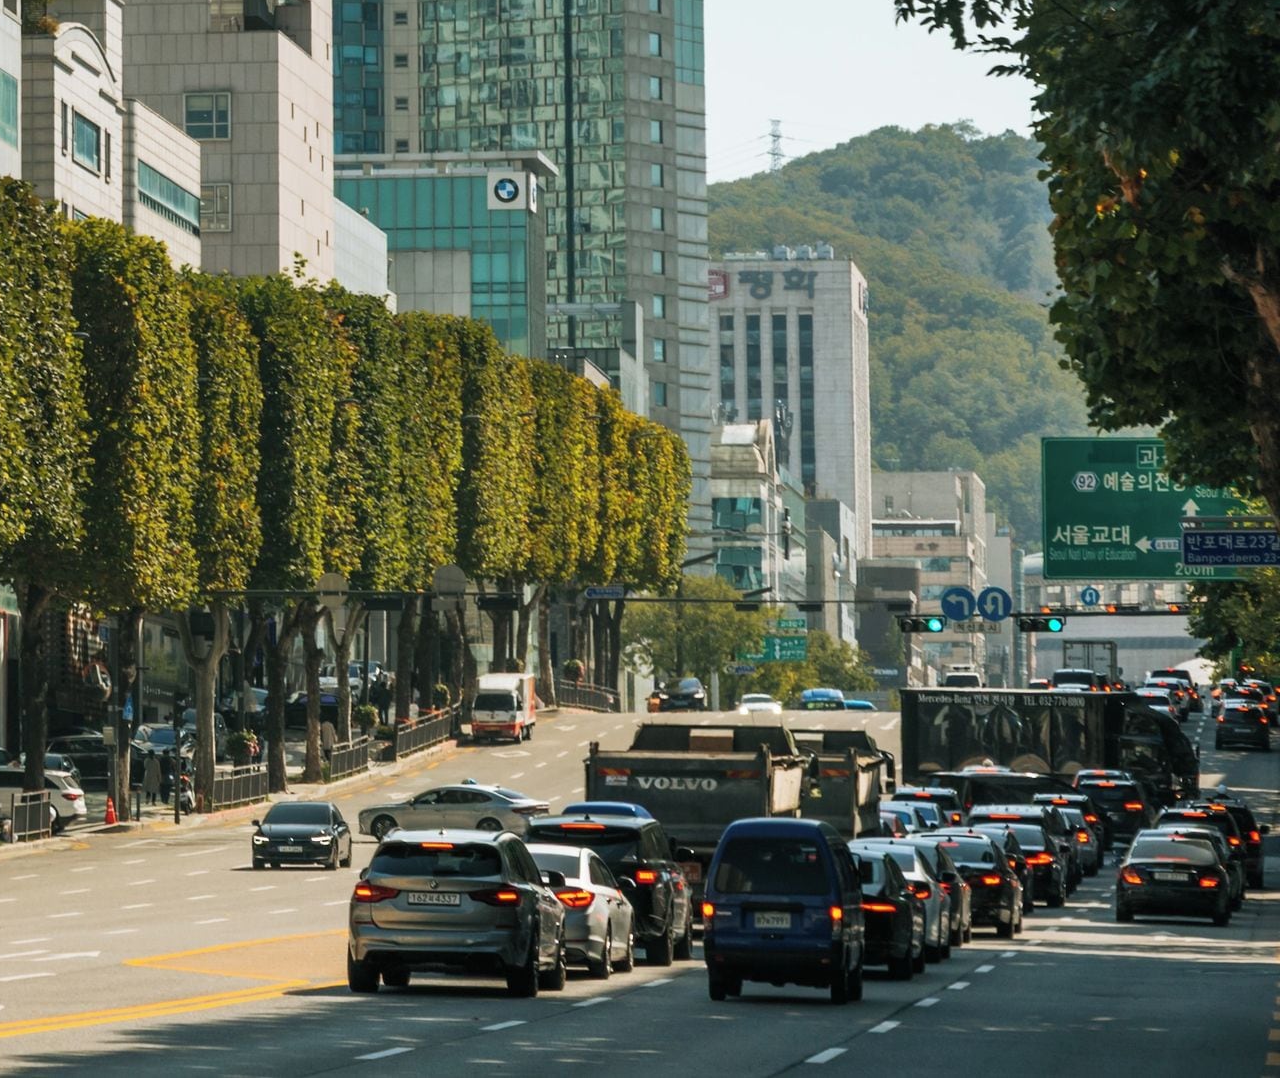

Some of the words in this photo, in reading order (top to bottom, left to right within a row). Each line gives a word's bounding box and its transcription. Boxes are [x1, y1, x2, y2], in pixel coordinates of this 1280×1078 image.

[1078, 474, 1094, 490] 92
[1195, 485, 1219, 499] Seoul
[1052, 524, 1131, 546] 서울교대
[1106, 547, 1137, 561] Education
[1187, 552, 1261, 564] Banpo-daero
[917, 693, 971, 705] Mercedes-Benz
[635, 776, 718, 791] VOLVO
